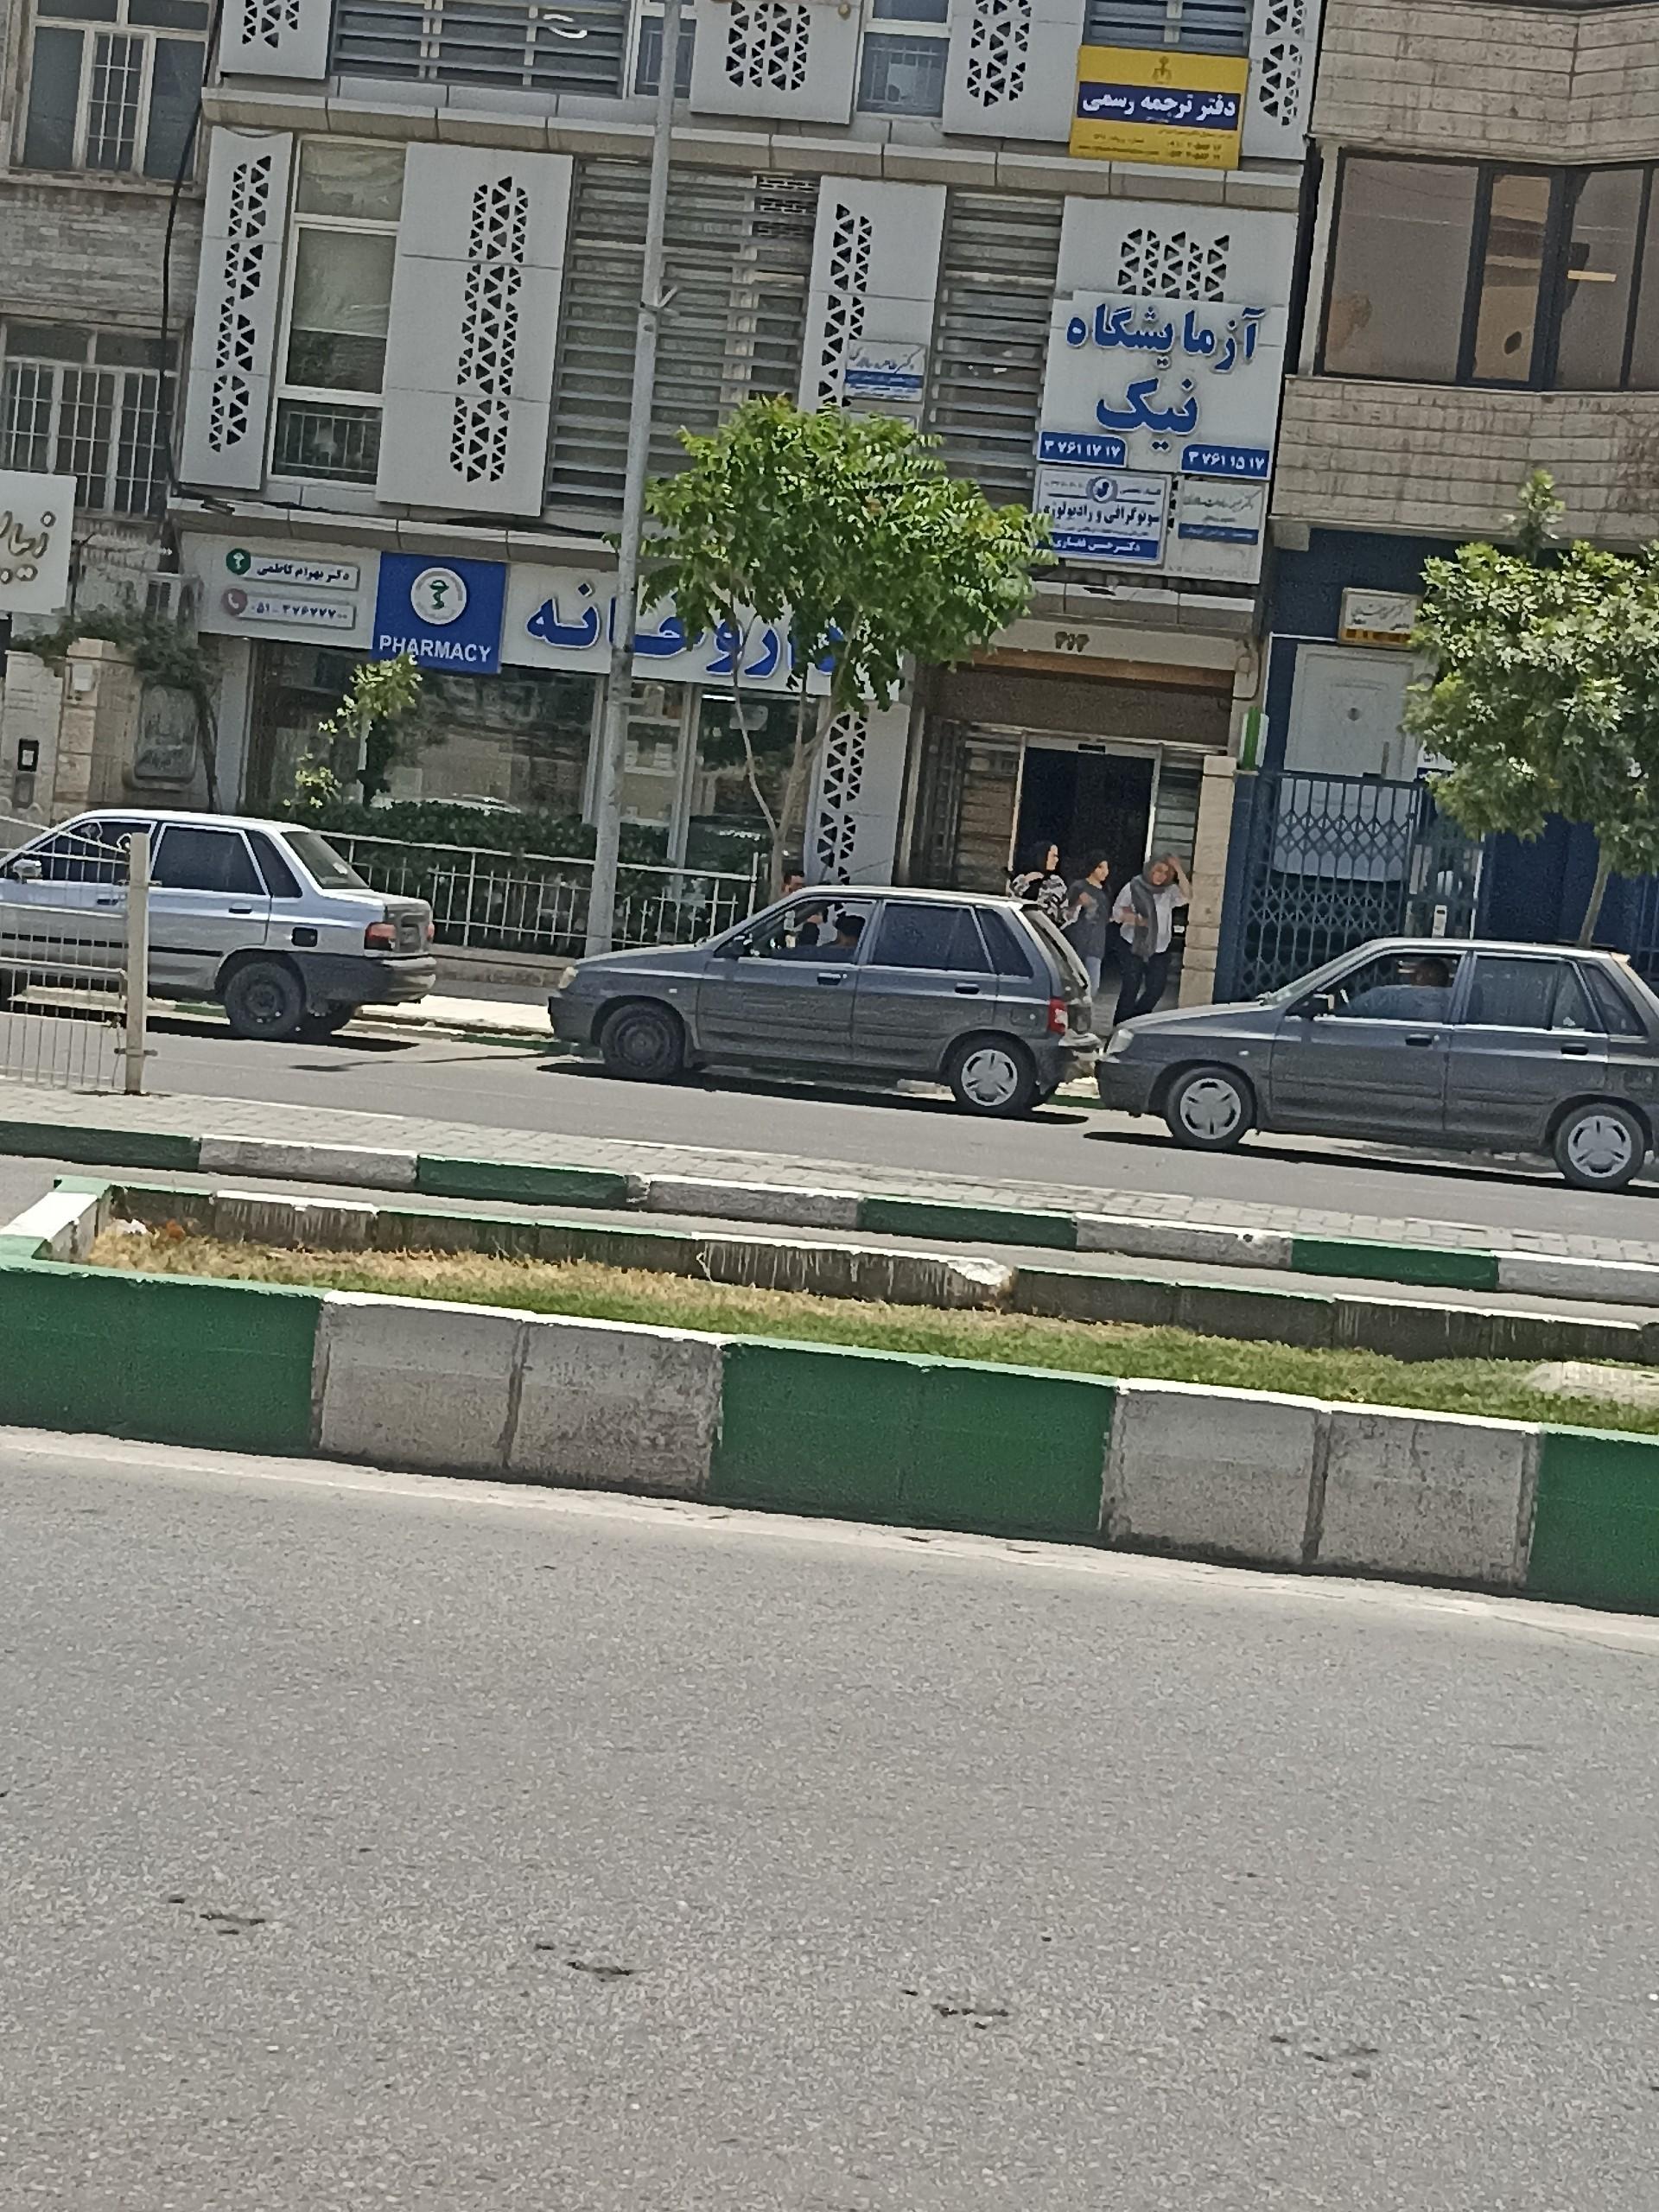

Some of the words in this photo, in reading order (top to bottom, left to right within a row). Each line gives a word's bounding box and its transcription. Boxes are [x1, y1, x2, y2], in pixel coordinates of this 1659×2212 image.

[1083, 93, 1135, 115] رسمی
[1141, 93, 1193, 119] ترجمه
[1196, 93, 1236, 121] دفتر
[1065, 302, 1266, 372] آزمایشگاه
[1096, 378, 1198, 452] نیک
[1103, 504, 1160, 527] سونوگرافی
[1112, 541, 1141, 554] دکتر
[295, 566, 324, 582] بهرام
[325, 569, 350, 583] دکتر
[379, 634, 492, 664] PHARMACY
